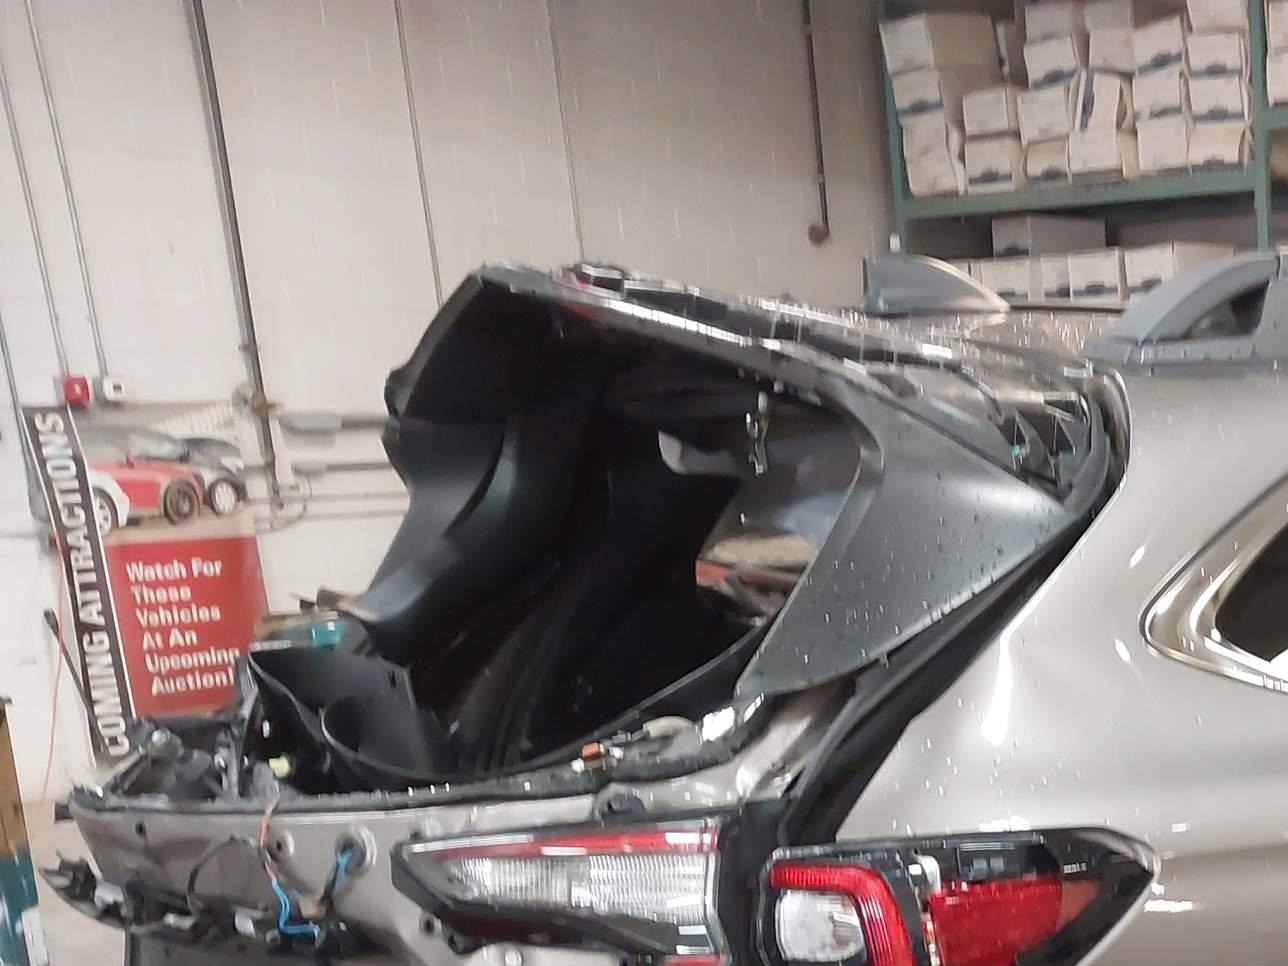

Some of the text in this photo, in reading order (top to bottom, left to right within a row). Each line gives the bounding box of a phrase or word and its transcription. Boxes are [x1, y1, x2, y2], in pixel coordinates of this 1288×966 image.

[126, 557, 223, 583] Watch For
[34, 411, 130, 756] COMING ATTRACTIONS
[131, 584, 192, 605] These
[135, 603, 221, 628] Vehicles
[143, 627, 198, 650] At An
[151, 667, 235, 696] Auction!
